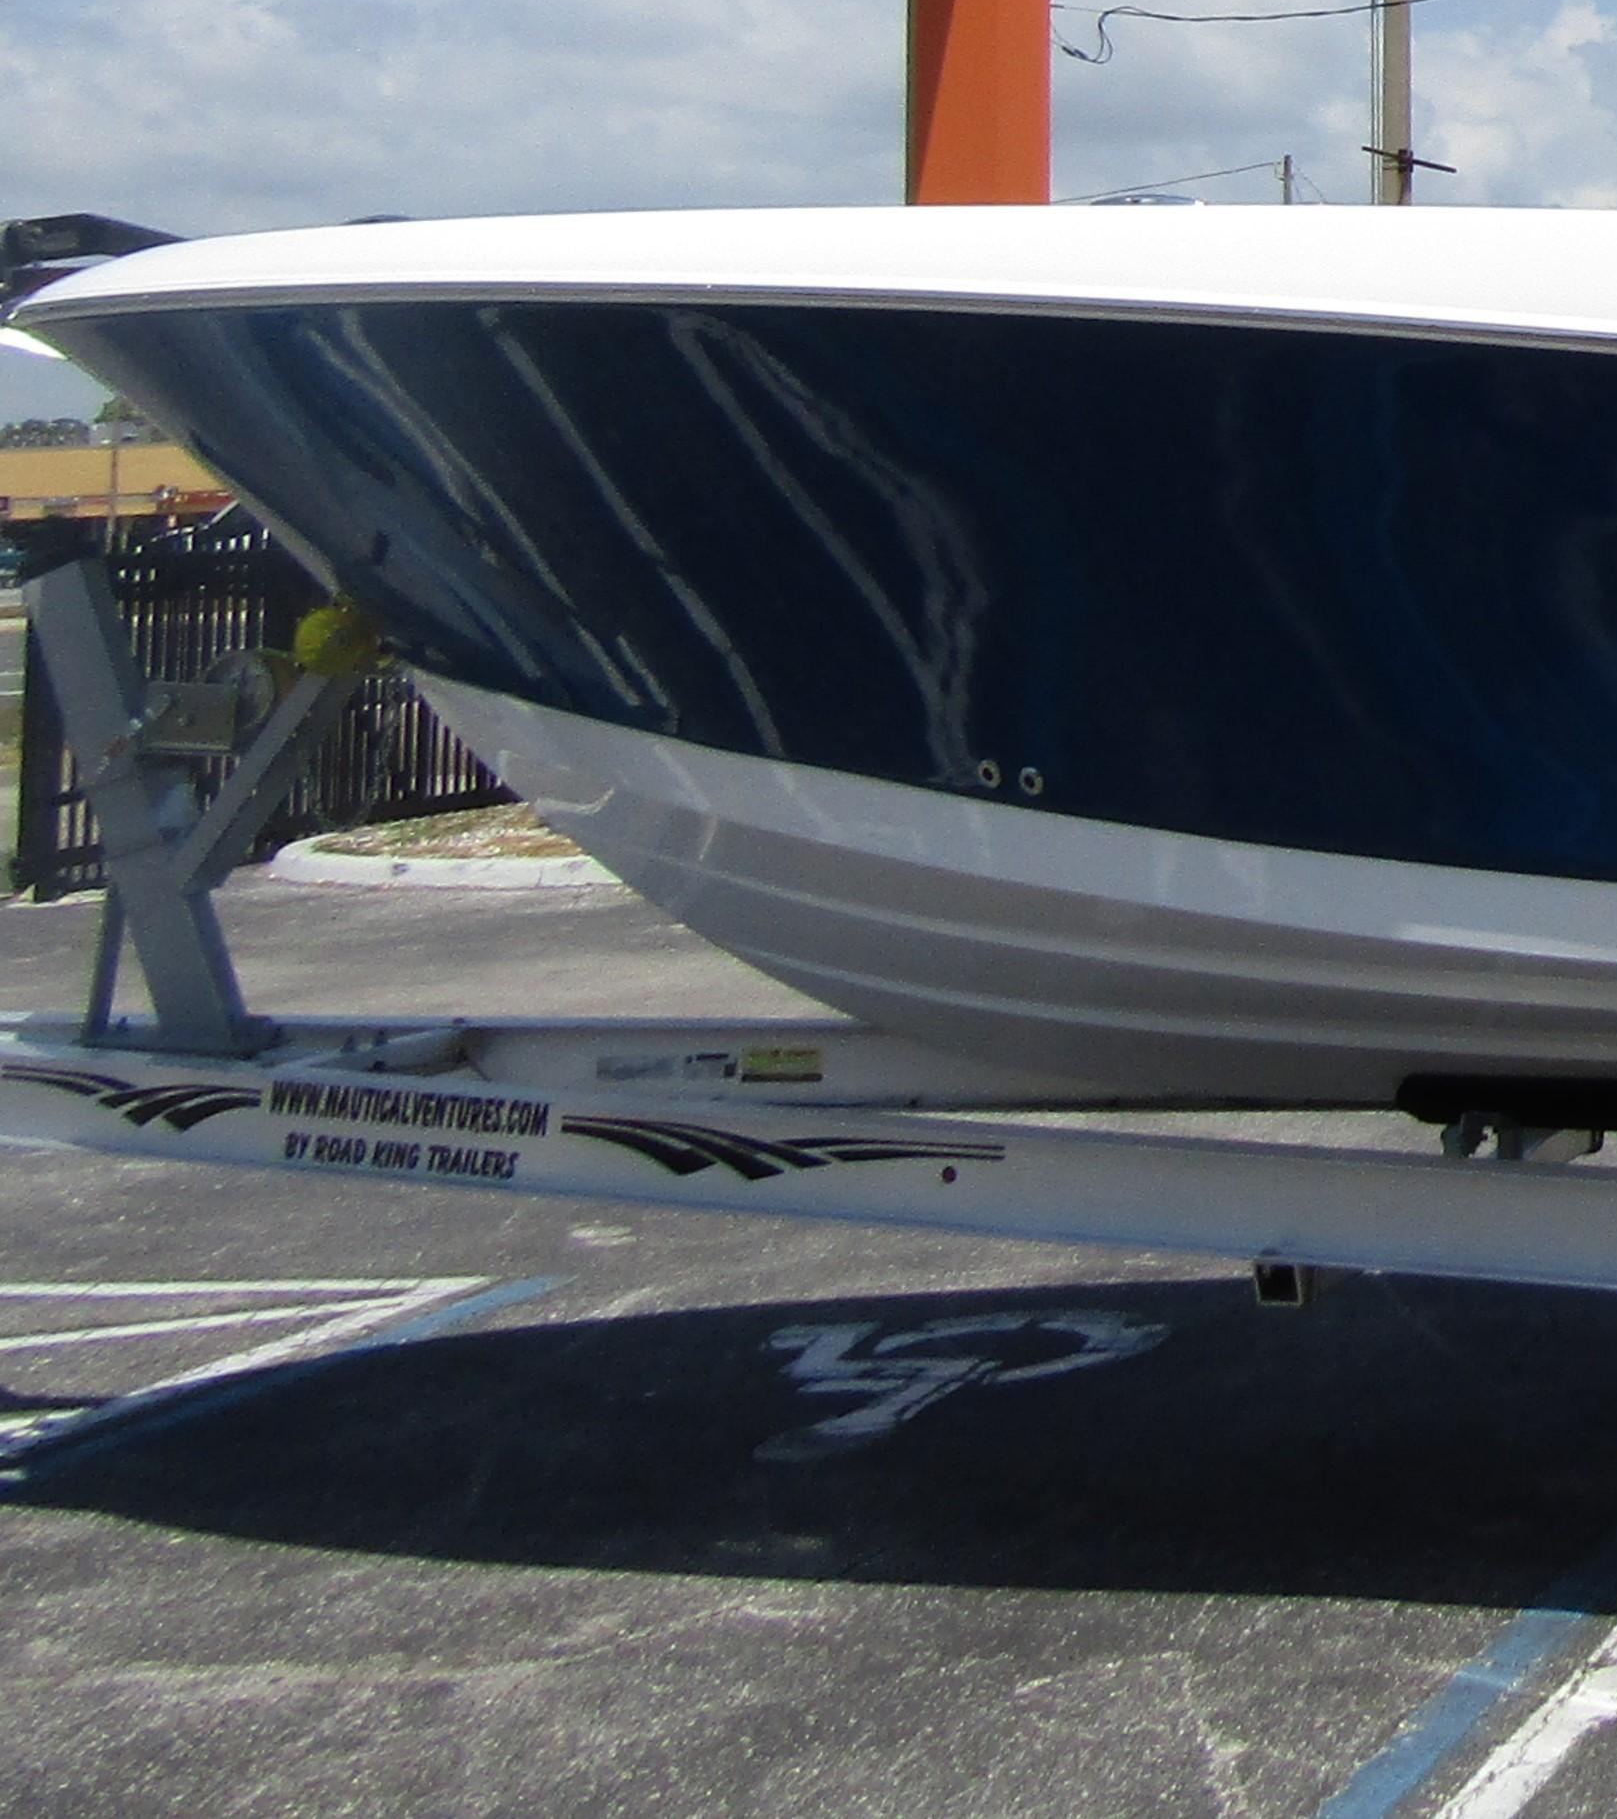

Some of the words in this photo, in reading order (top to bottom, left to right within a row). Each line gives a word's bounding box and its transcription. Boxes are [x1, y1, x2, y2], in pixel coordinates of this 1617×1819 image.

[269, 1079, 549, 1137] WWW.NAUTICALVENTURES.COM
[285, 1133, 311, 1159] BY
[314, 1135, 367, 1165] ROAD
[372, 1141, 421, 1170] KING
[427, 1146, 520, 1180] TRAILERS
